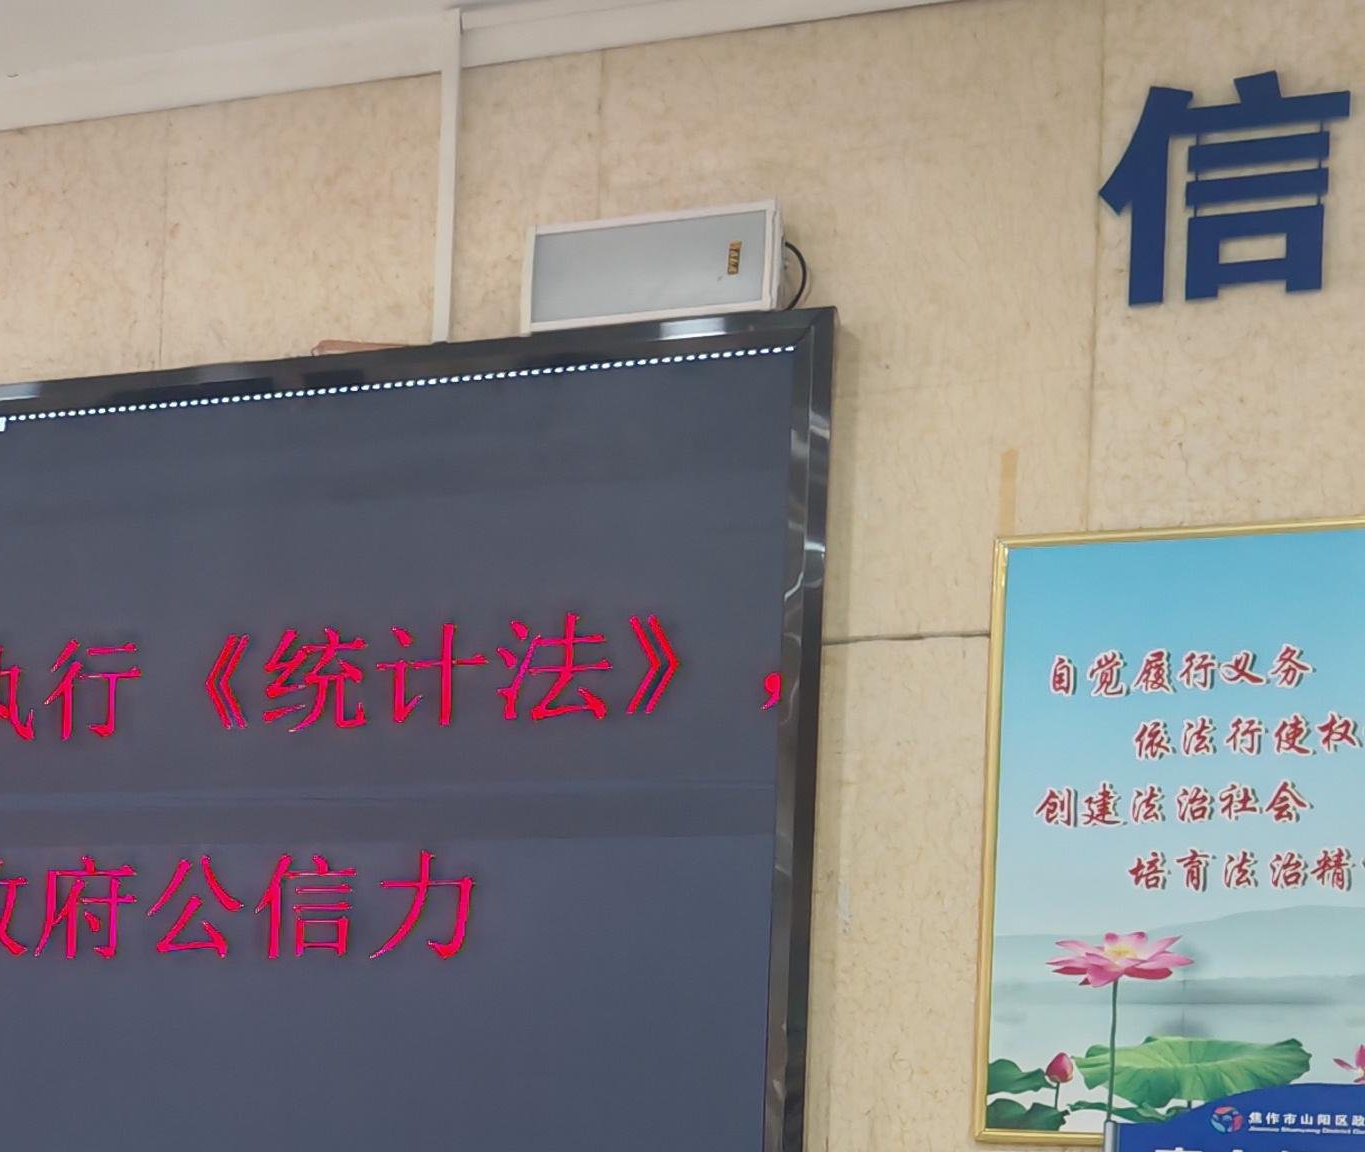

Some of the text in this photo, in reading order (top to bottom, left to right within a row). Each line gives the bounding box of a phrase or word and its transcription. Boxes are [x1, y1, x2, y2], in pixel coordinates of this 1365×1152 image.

[1098, 69, 1352, 307] 信
[1050, 645, 1313, 696] 自觉履行义务
[1133, 712, 1365, 760] 依法行使权
[1036, 780, 1311, 825] 创建法治社会
[1128, 847, 1365, 892] 培育法治精
